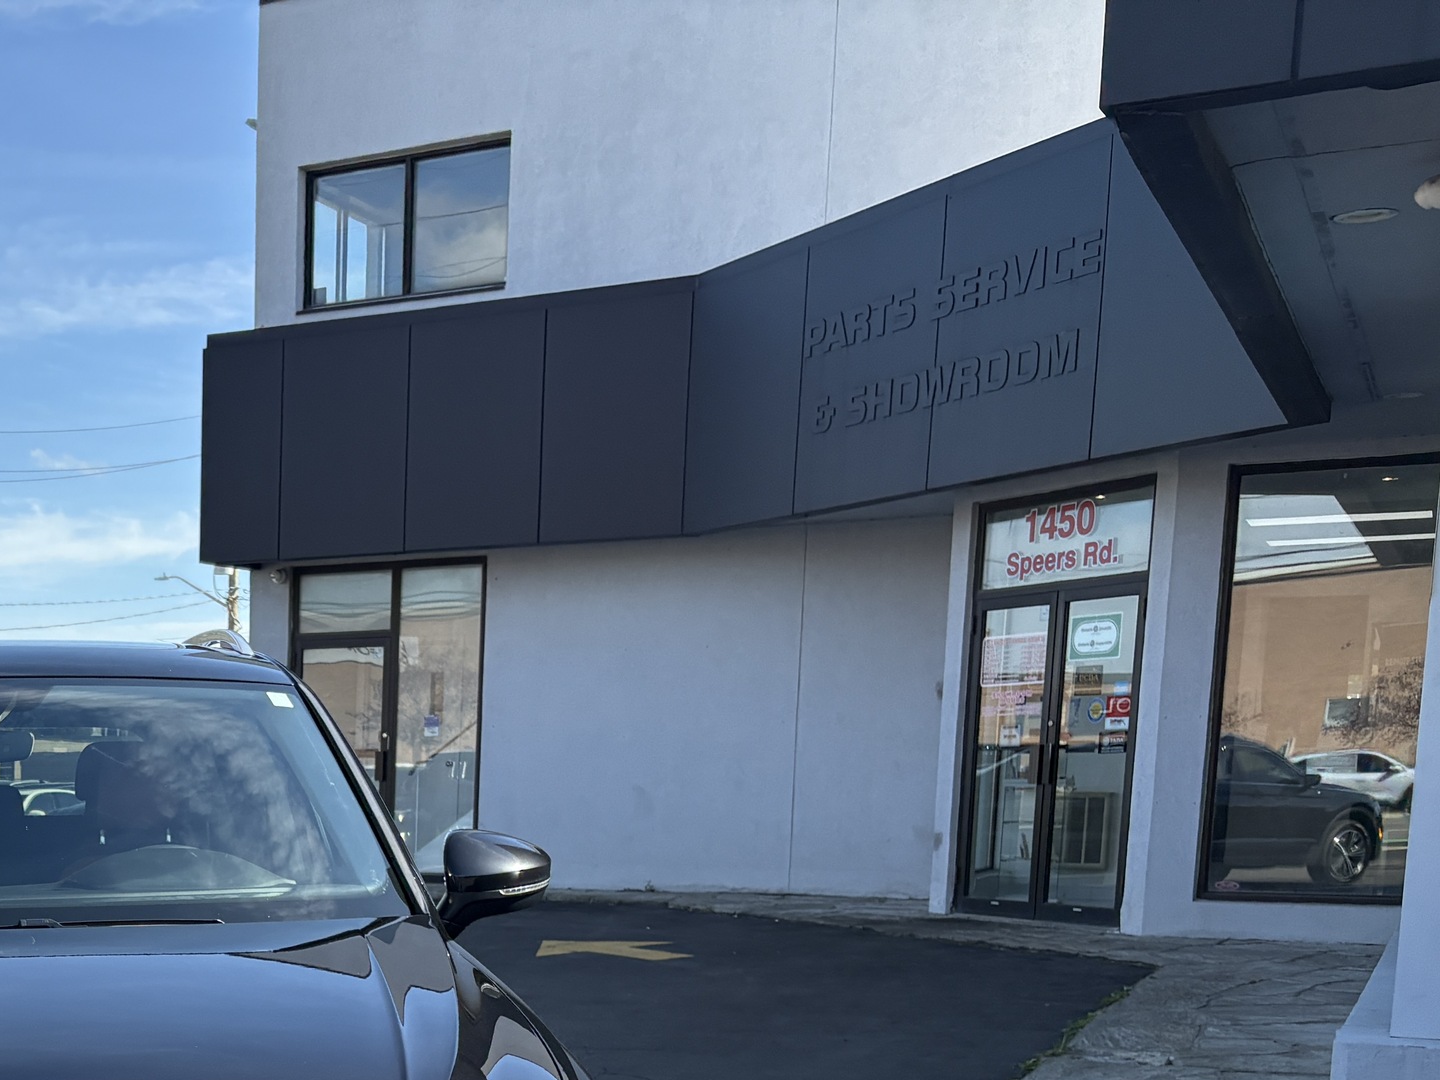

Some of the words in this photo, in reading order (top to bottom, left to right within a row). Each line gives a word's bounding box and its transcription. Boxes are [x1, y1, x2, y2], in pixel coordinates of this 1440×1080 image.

[806, 287, 916, 358] PARTS
[931, 228, 1103, 321] SERVICE
[814, 396, 836, 434] &
[845, 328, 1079, 428] SHOWROOM
[1006, 549, 1078, 581] Speers
[1082, 538, 1119, 567] Rd.
[1025, 500, 1097, 544] 1450
